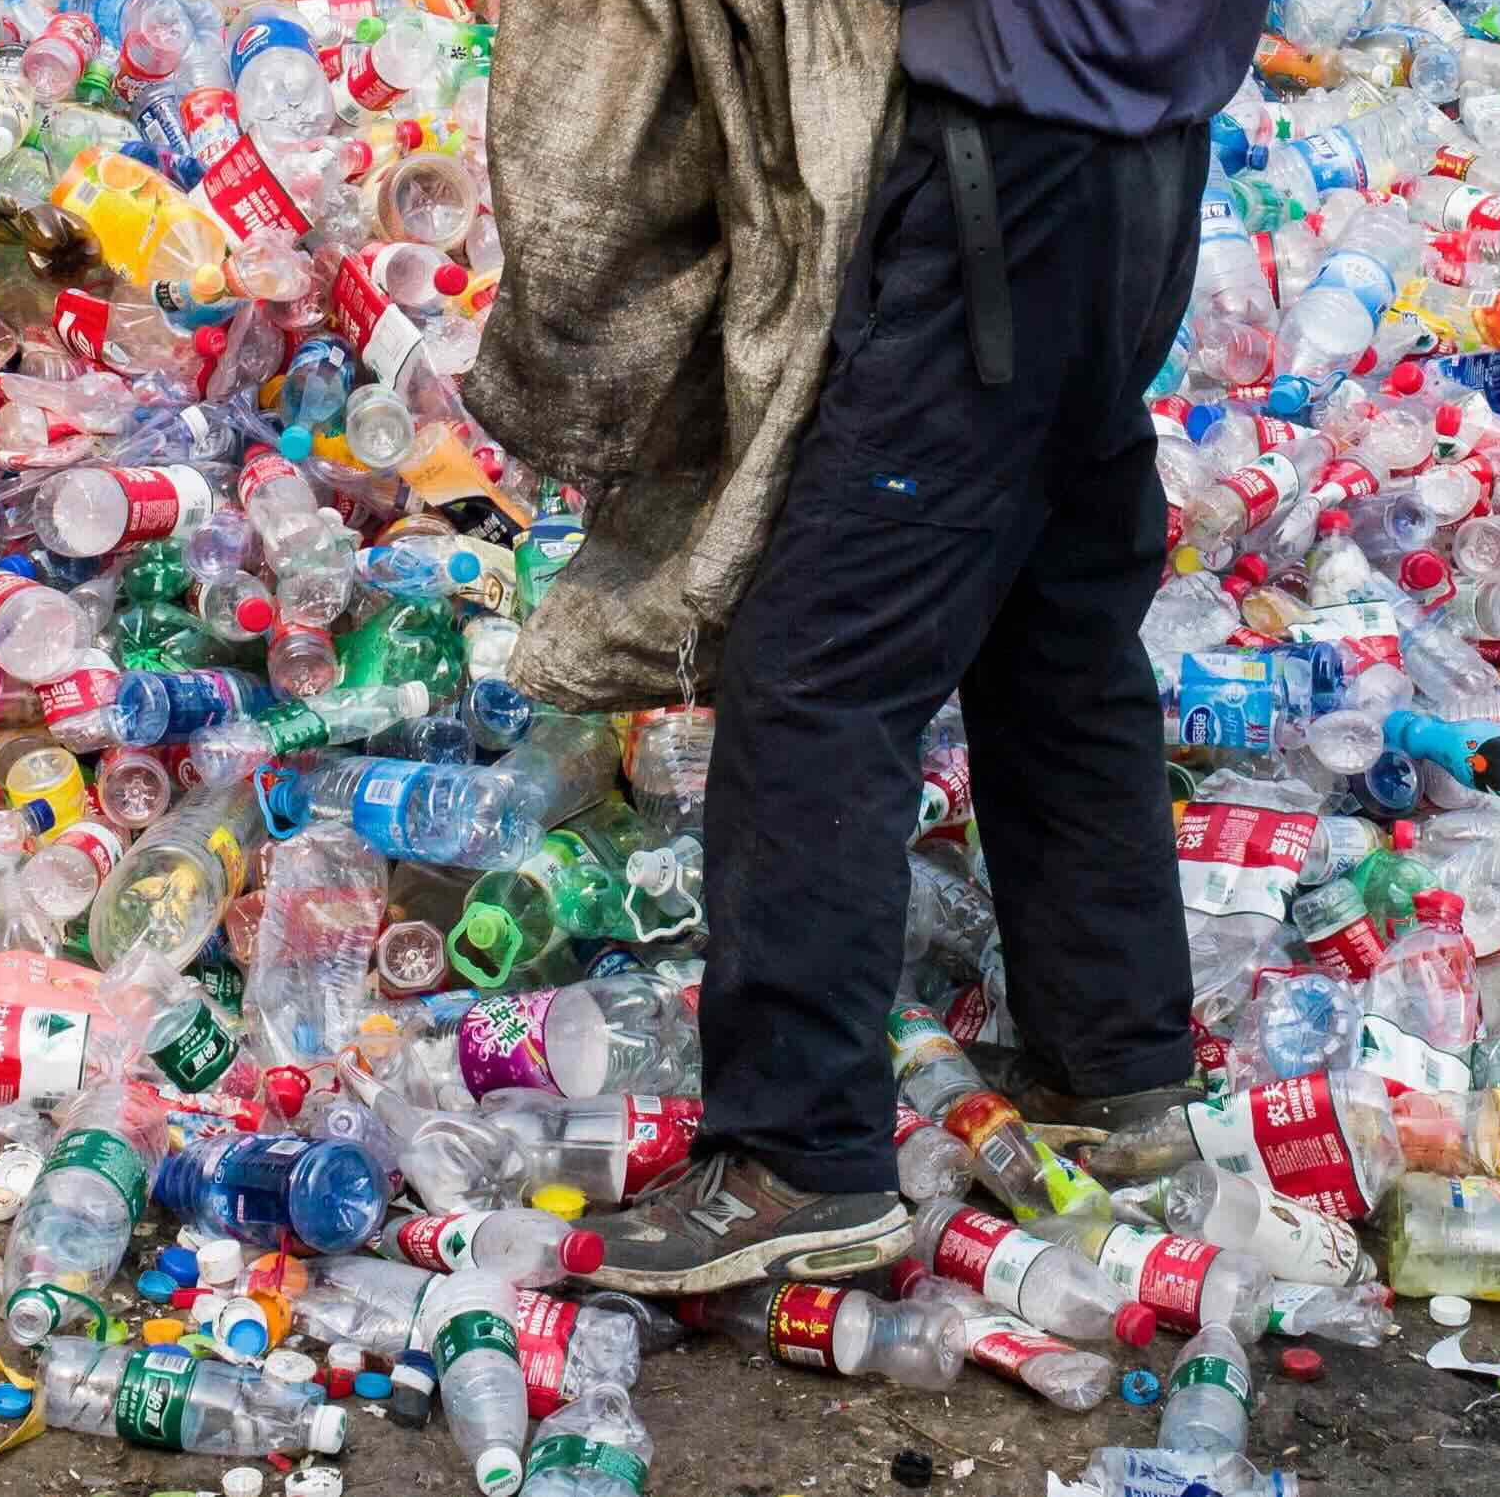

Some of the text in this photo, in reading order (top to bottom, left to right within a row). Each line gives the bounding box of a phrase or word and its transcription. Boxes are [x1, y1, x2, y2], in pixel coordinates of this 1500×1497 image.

[1269, 837, 1310, 864] 山泉
[1267, 1081, 1290, 1127] 农夫
[778, 1311, 829, 1339] 加多宝
